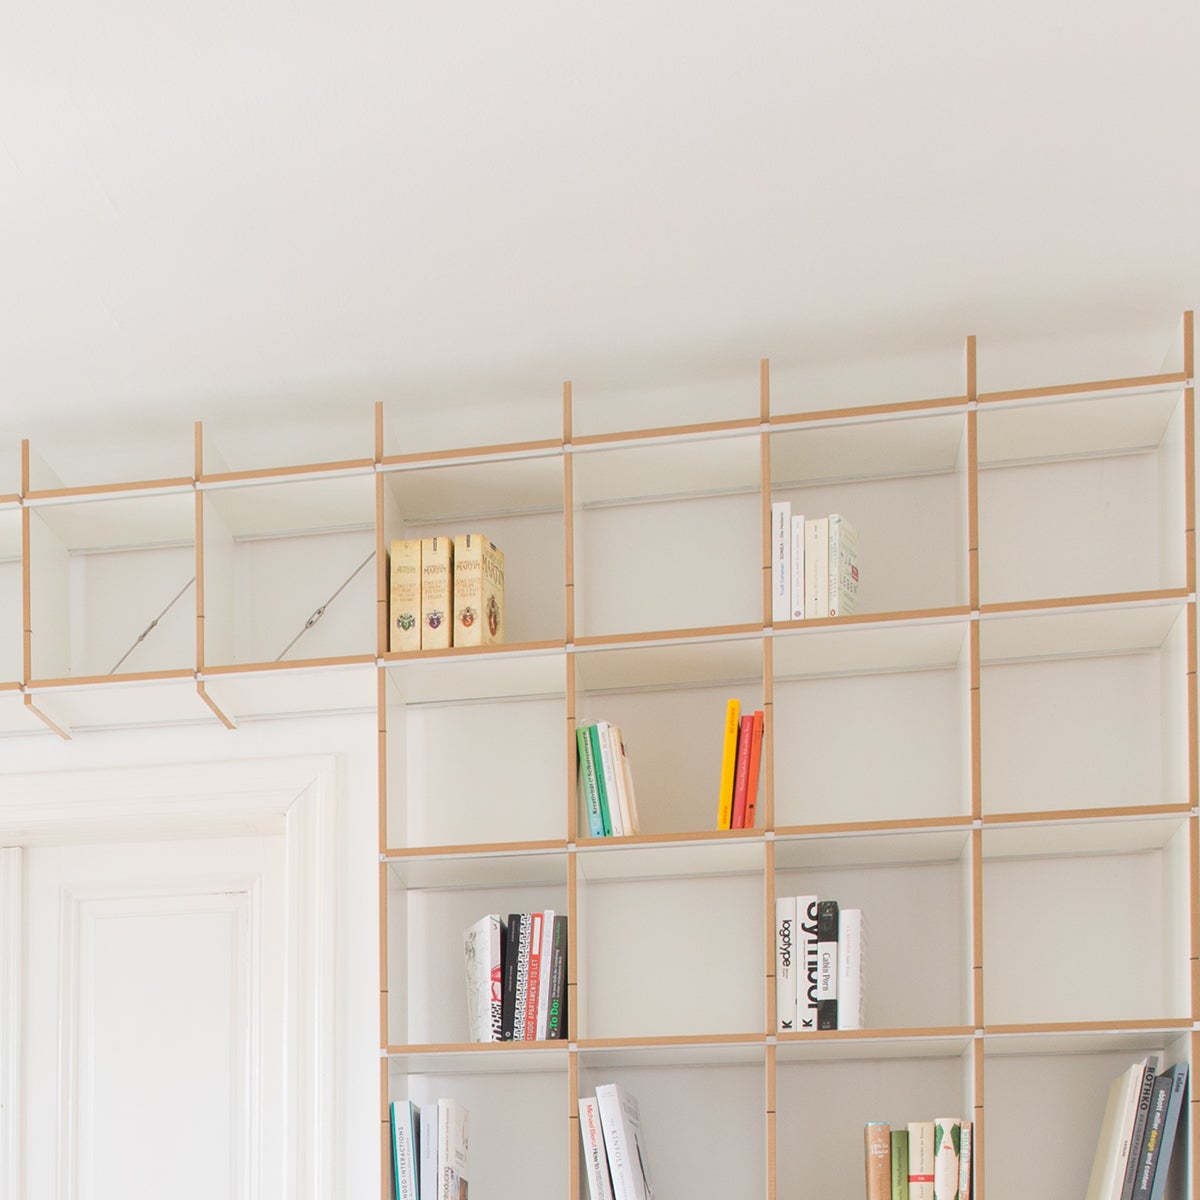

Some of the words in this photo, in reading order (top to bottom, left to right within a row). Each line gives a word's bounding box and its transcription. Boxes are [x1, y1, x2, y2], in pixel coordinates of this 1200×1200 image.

[779, 920, 792, 967] logotype
[822, 952, 830, 974] Cabin
[822, 974, 830, 992] Porn
[551, 998, 559, 1014] Do:
[549, 1016, 558, 1029] To
[1140, 1066, 1155, 1111] ROTHKO
[1157, 1090, 1166, 1111] abbott
[612, 1130, 623, 1169] KINFOLK
[1147, 1129, 1159, 1151] design
[398, 1126, 407, 1177] INTERACTIONS
[1141, 1165, 1152, 1190] content
